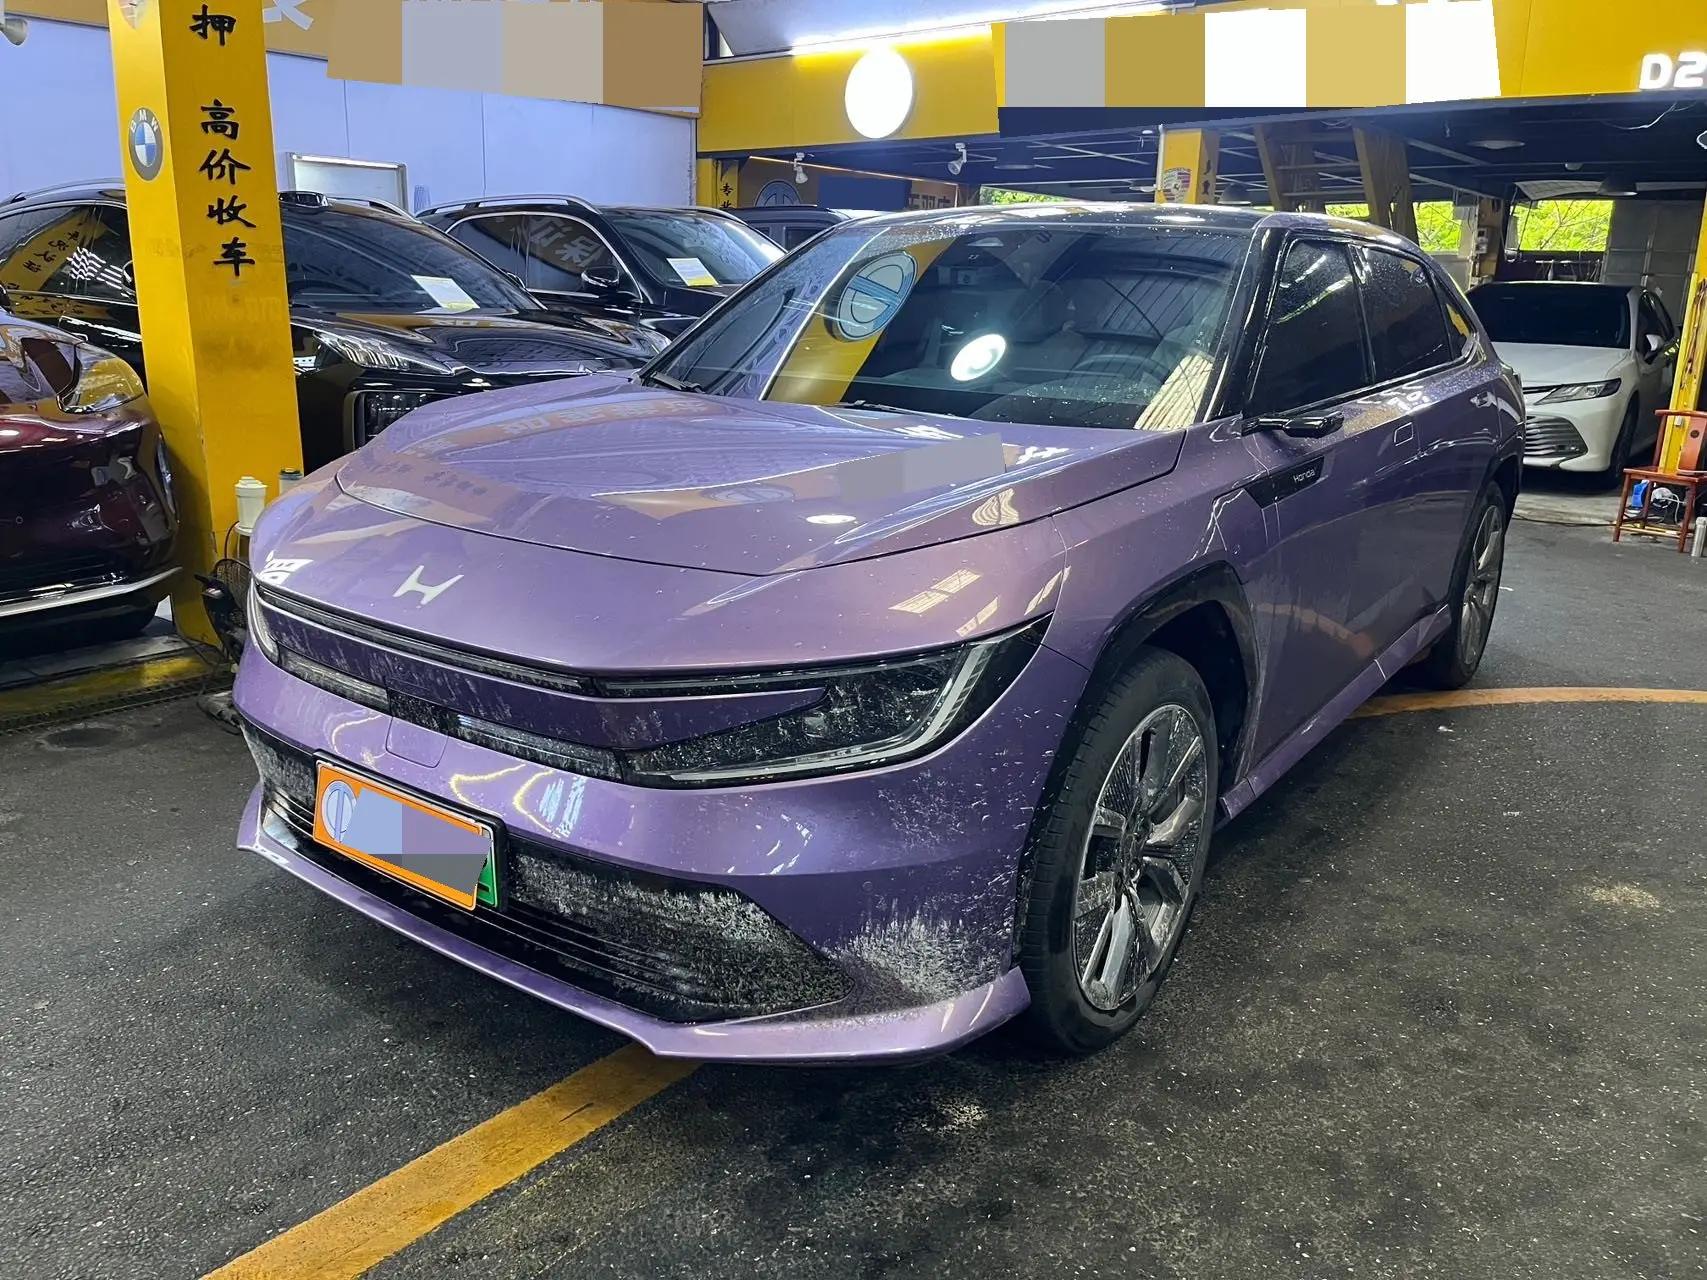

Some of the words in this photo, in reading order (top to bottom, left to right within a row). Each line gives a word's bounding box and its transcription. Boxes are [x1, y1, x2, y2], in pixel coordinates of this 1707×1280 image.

[188, 4, 237, 46] 押
[1639, 51, 1707, 90] D2
[199, 98, 257, 277] 高价收车
